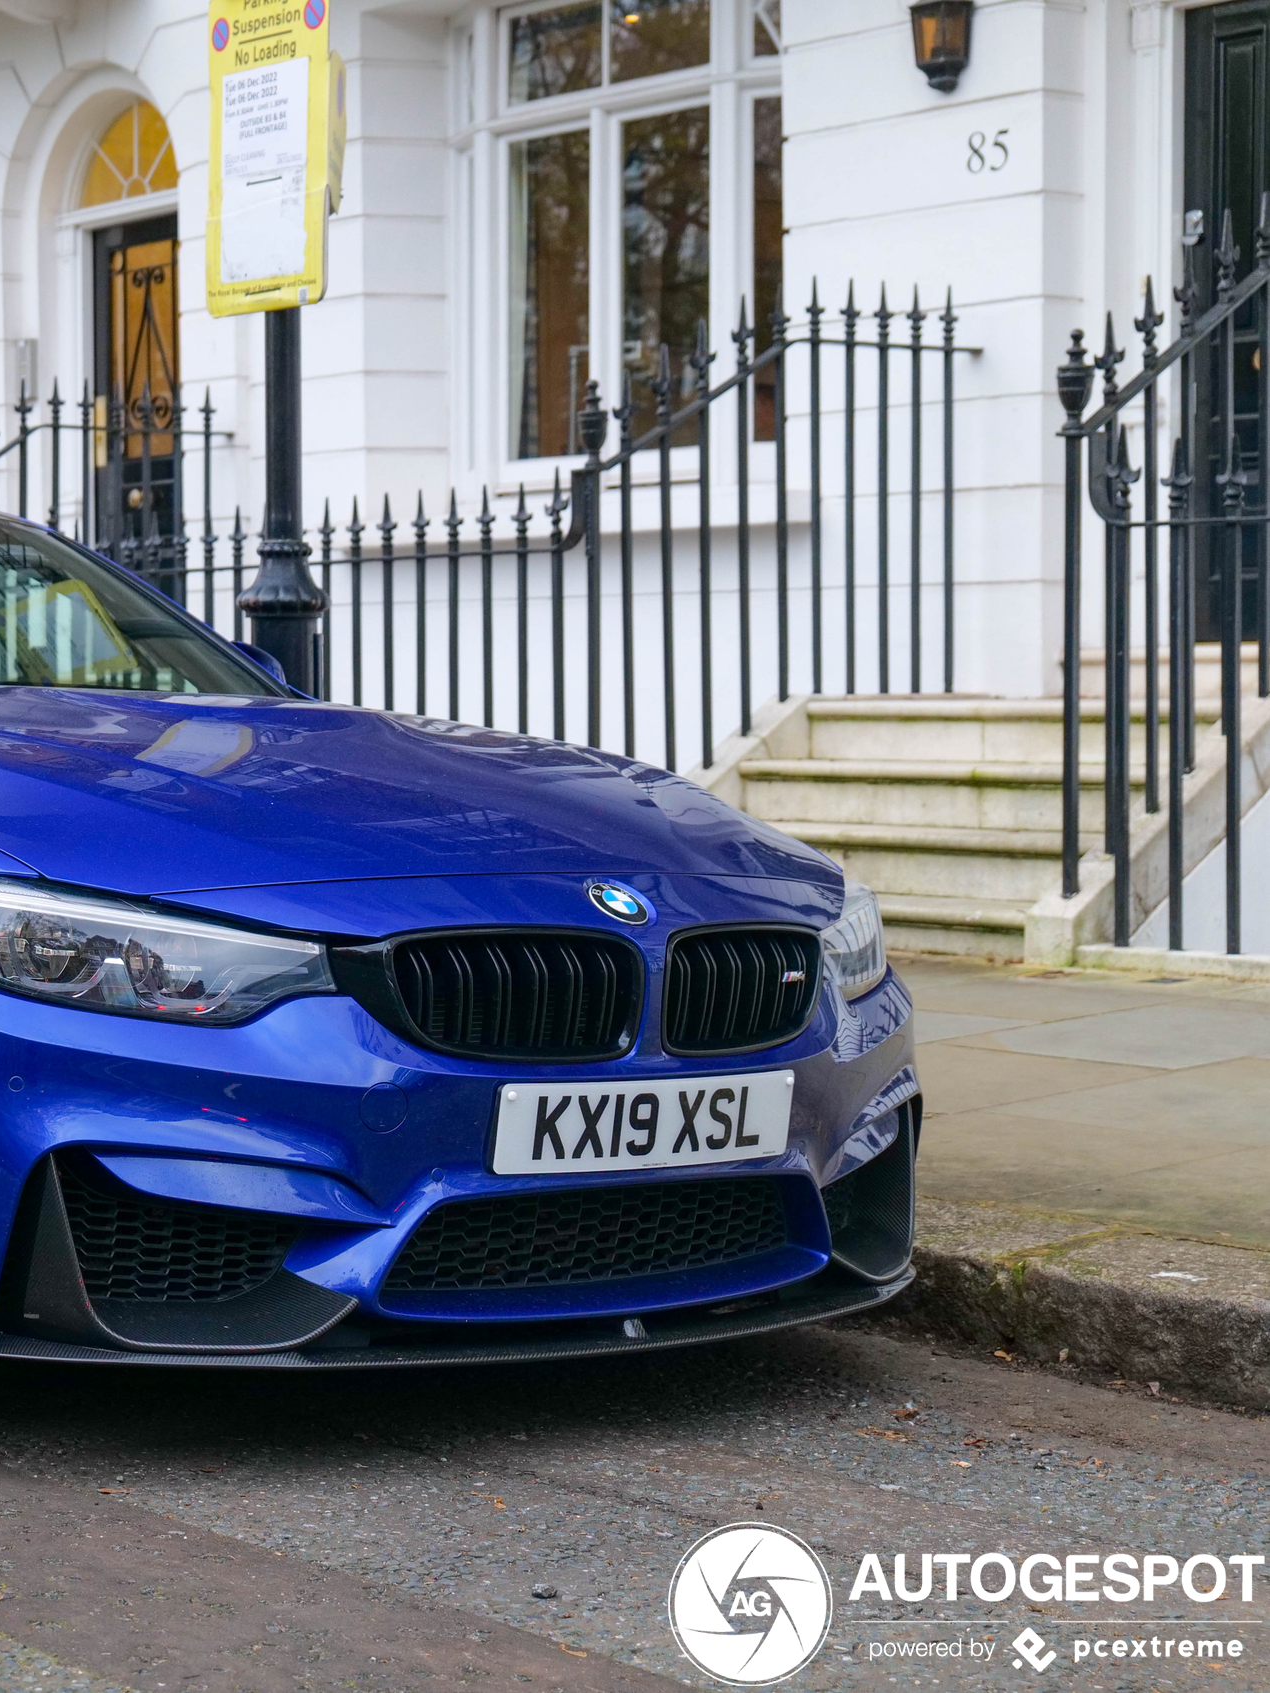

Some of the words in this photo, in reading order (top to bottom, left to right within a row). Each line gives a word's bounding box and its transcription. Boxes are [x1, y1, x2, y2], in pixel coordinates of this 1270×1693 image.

[233, 8, 300, 36] Suspension
[235, 49, 249, 66] No
[254, 40, 296, 62] Loading
[225, 83, 236, 93] Tue
[238, 80, 246, 90] 06
[247, 77, 259, 88] Dec
[261, 71, 278, 84] 2022
[225, 97, 236, 107] Tue
[238, 94, 246, 104] 06
[247, 91, 259, 102] Dec
[261, 85, 278, 98] 2022
[225, 110, 236, 119] From
[257, 102, 268, 111] Until
[240, 116, 263, 129] OUTSIDE
[273, 112, 278, 121] &
[239, 129, 254, 140] (FULL
[255, 121, 288, 135] FRONTAGE)
[966, 128, 1009, 174] 85
[532, 1093, 660, 1160] KX19
[672, 1086, 760, 1153] XSL
